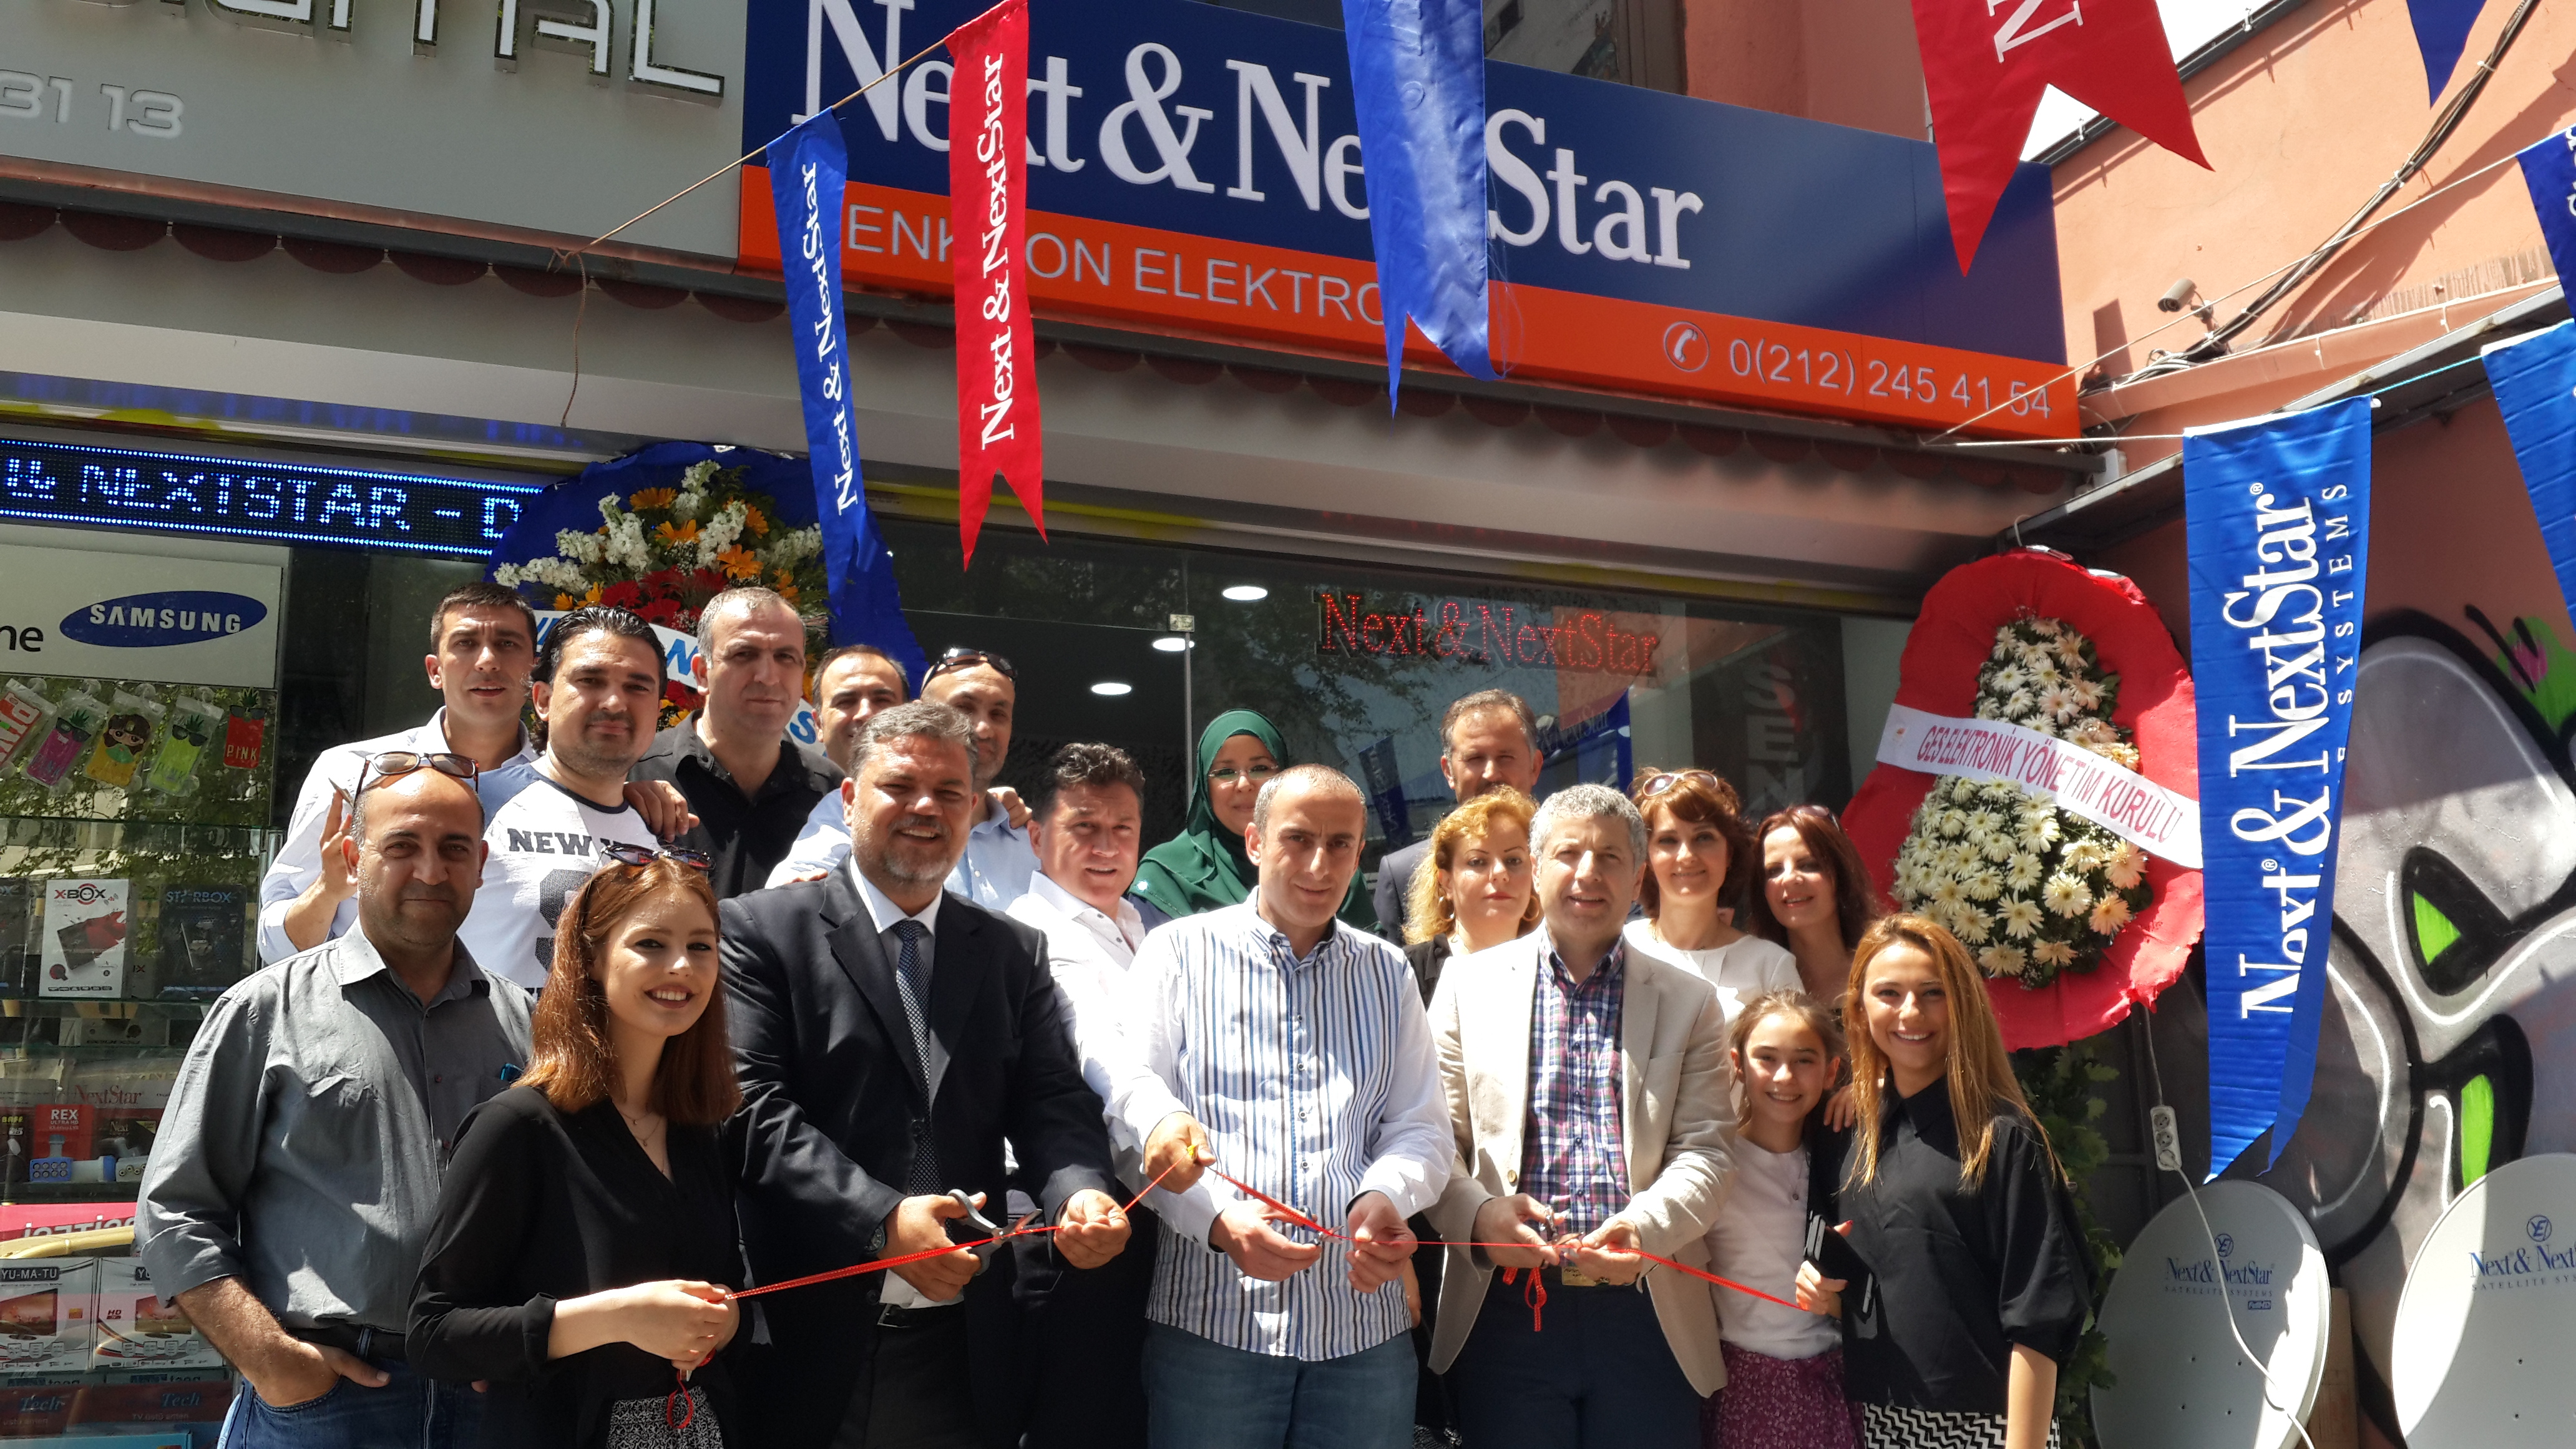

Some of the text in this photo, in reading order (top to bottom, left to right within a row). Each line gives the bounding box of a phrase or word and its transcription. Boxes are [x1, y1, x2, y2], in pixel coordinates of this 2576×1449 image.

[99, 83, 185, 140] 13
[790, 0, 1086, 173] Net
[1099, 42, 1215, 195] &
[1226, 59, 1704, 269] NeStar
[977, 53, 1014, 450] Next & NextStar
[802, 162, 859, 516] Next & NextStar
[1729, 338, 2052, 419] 0(212) 245 41 54
[80, 464, 412, 532] NEXTSTAR
[89, 603, 242, 634] SAMSUNG
[2321, 484, 2354, 706] SYSTEMS
[1320, 593, 1657, 672] Next & NextStar
[2223, 495, 2330, 778] NextStar
[227, 744, 258, 761] PINK
[2016, 738, 2105, 805] YÖNETİM
[2094, 778, 2183, 843] KURULU
[2231, 785, 2331, 856] &
[507, 827, 593, 857] NEW
[51, 1109, 79, 1121] REX
[2166, 1257, 2273, 1286] Next & NextStar
[2469, 1242, 2576, 1278] Next & Next
[162, 1392, 201, 1407] Tech
